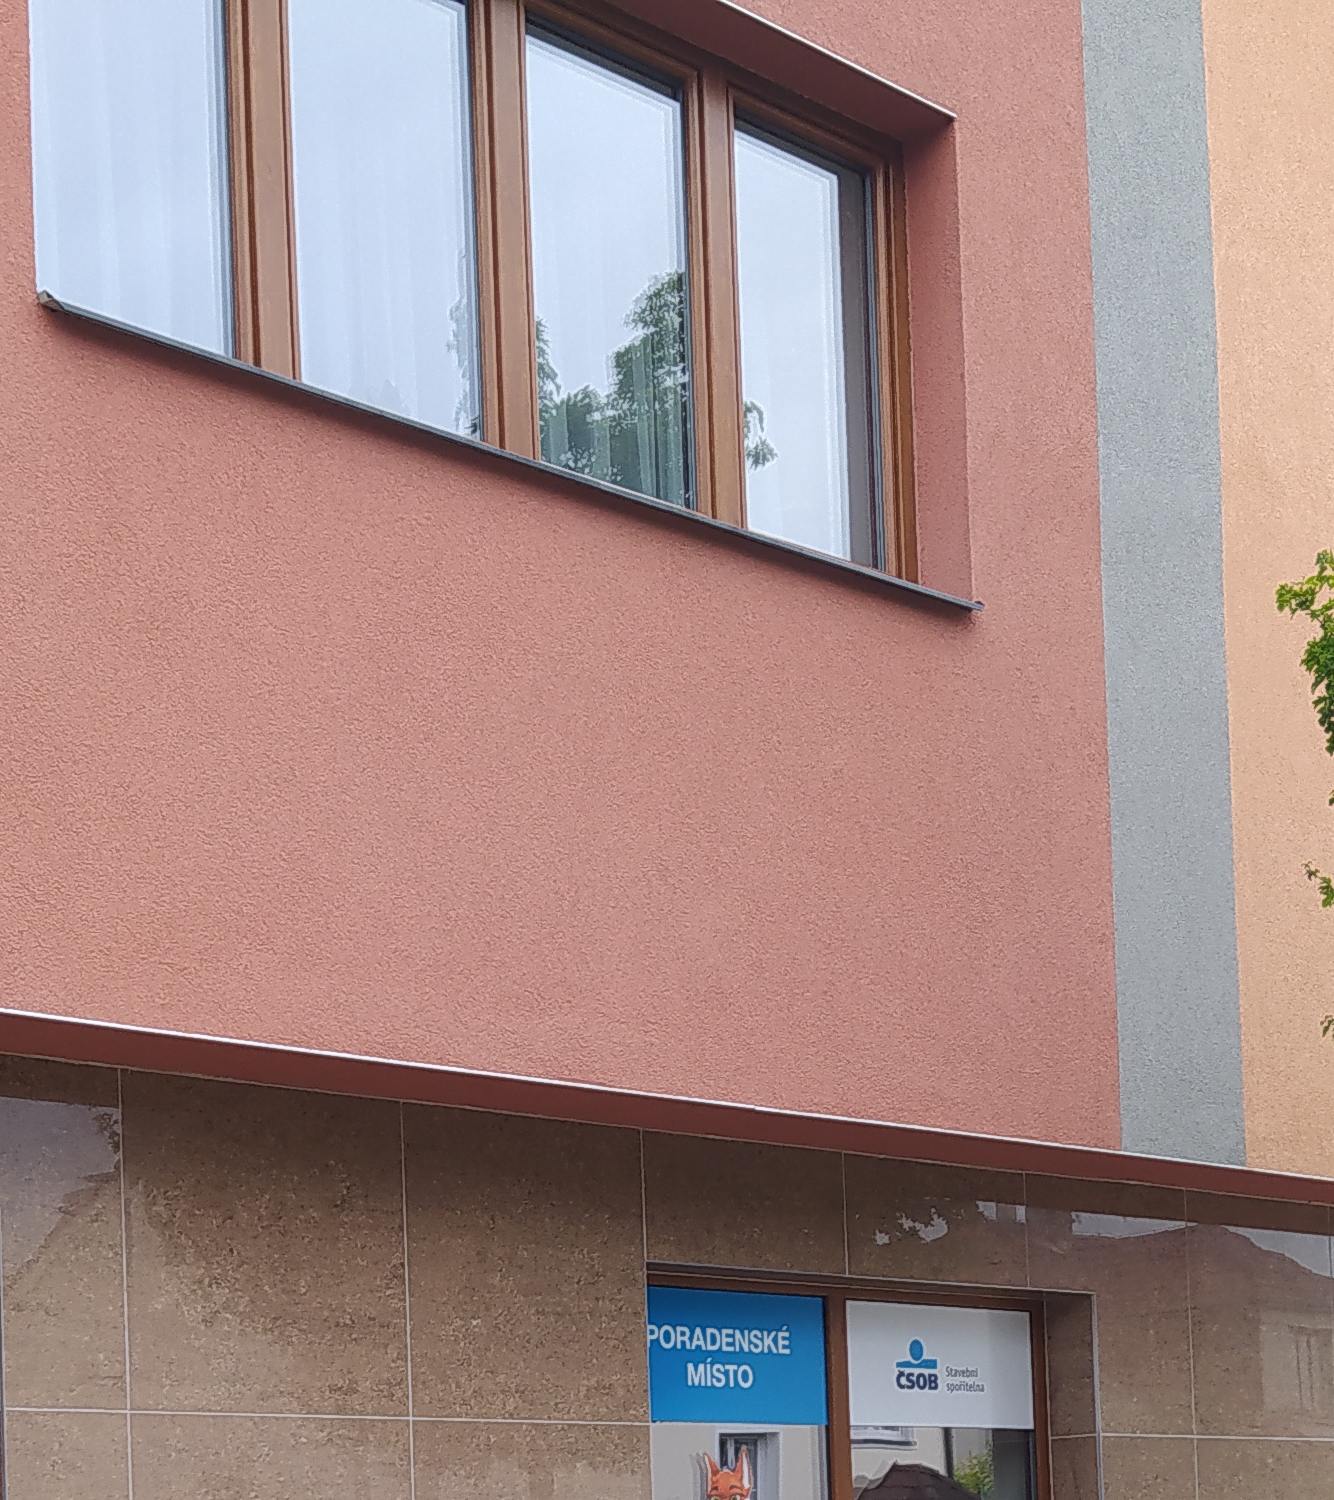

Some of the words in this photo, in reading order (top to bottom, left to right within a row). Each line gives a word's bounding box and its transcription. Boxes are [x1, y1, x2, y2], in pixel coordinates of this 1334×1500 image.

[647, 1324, 791, 1355] PORADENSKÉ
[687, 1357, 754, 1389] MÍSTO
[896, 1369, 939, 1390] ČSOB
[945, 1366, 979, 1378] Stavební
[946, 1381, 985, 1394] spořitelna
